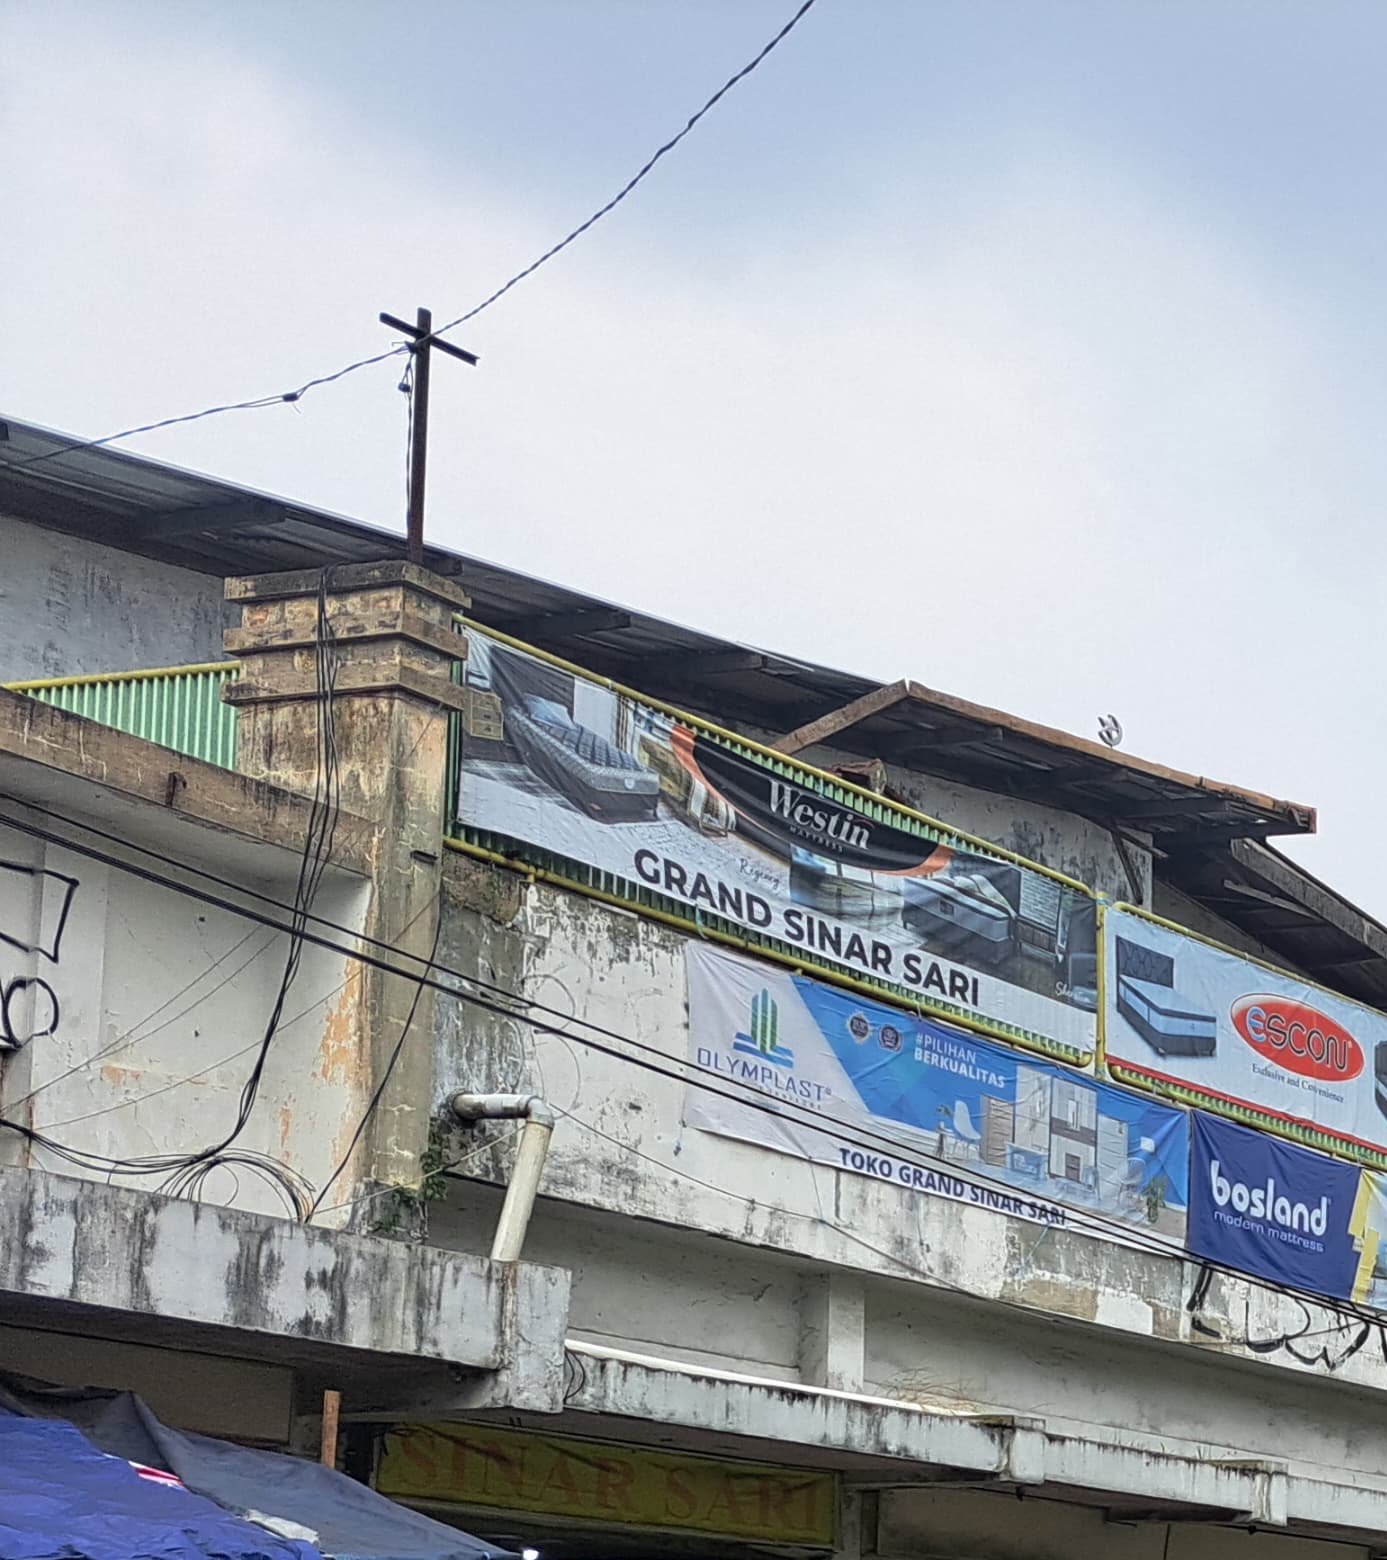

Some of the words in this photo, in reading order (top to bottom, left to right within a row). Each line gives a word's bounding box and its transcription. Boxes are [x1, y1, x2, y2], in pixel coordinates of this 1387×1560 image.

[767, 778, 873, 851] Westin
[634, 848, 772, 928] GRAND
[784, 908, 892, 975] SINAR
[904, 952, 979, 1006] SARI
[913, 1046, 1006, 1088] BERKUALITAS
[915, 1032, 977, 1064] #PILIHAN
[840, 1147, 894, 1179] TOKO
[899, 1164, 965, 1200] GRAND
[969, 1182, 1023, 1219] SINAR
[1209, 1160, 1328, 1236] bosland
[1213, 1210, 1264, 1237] modern
[1267, 1221, 1324, 1253] mattress
[399, 1431, 640, 1515] SINAR
[665, 1467, 821, 1531] SARI
